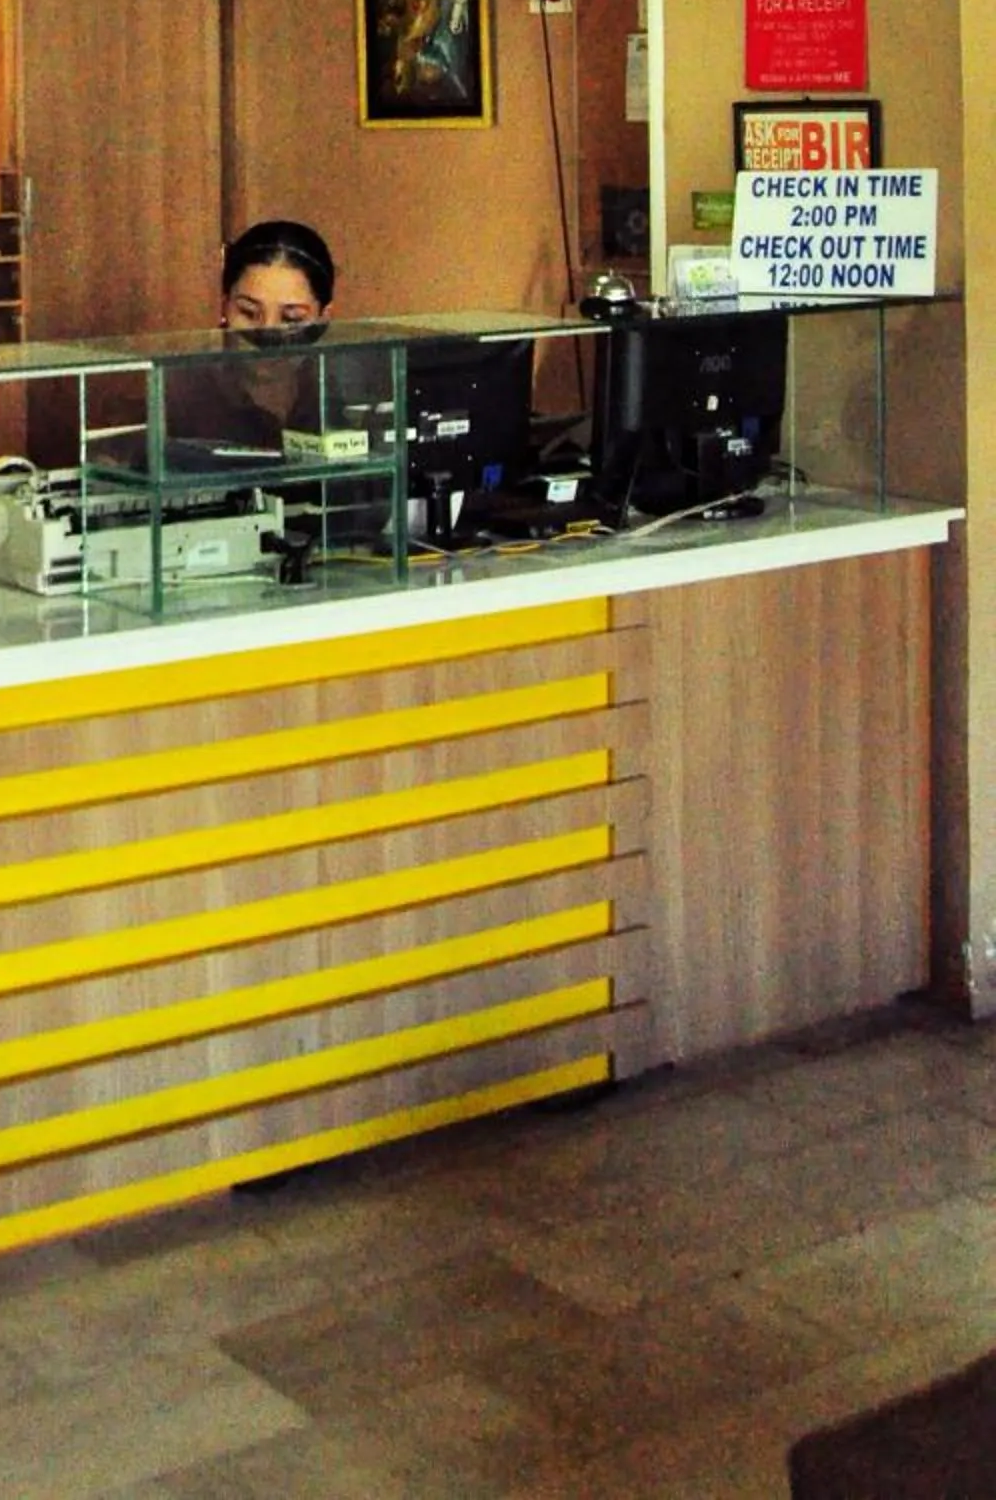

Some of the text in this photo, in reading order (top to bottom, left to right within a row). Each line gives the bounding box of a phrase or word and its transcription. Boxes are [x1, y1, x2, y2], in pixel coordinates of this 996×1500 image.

[744, 121, 800, 147] ASK FOR
[801, 121, 871, 170] BIR
[744, 148, 801, 169] RECEIPT
[751, 175, 922, 197] CHECK IN TIME
[791, 205, 877, 227] 2:00 PM
[740, 235, 926, 259] CHECK OUT TIME
[768, 263, 895, 287] 12:00 NOON
